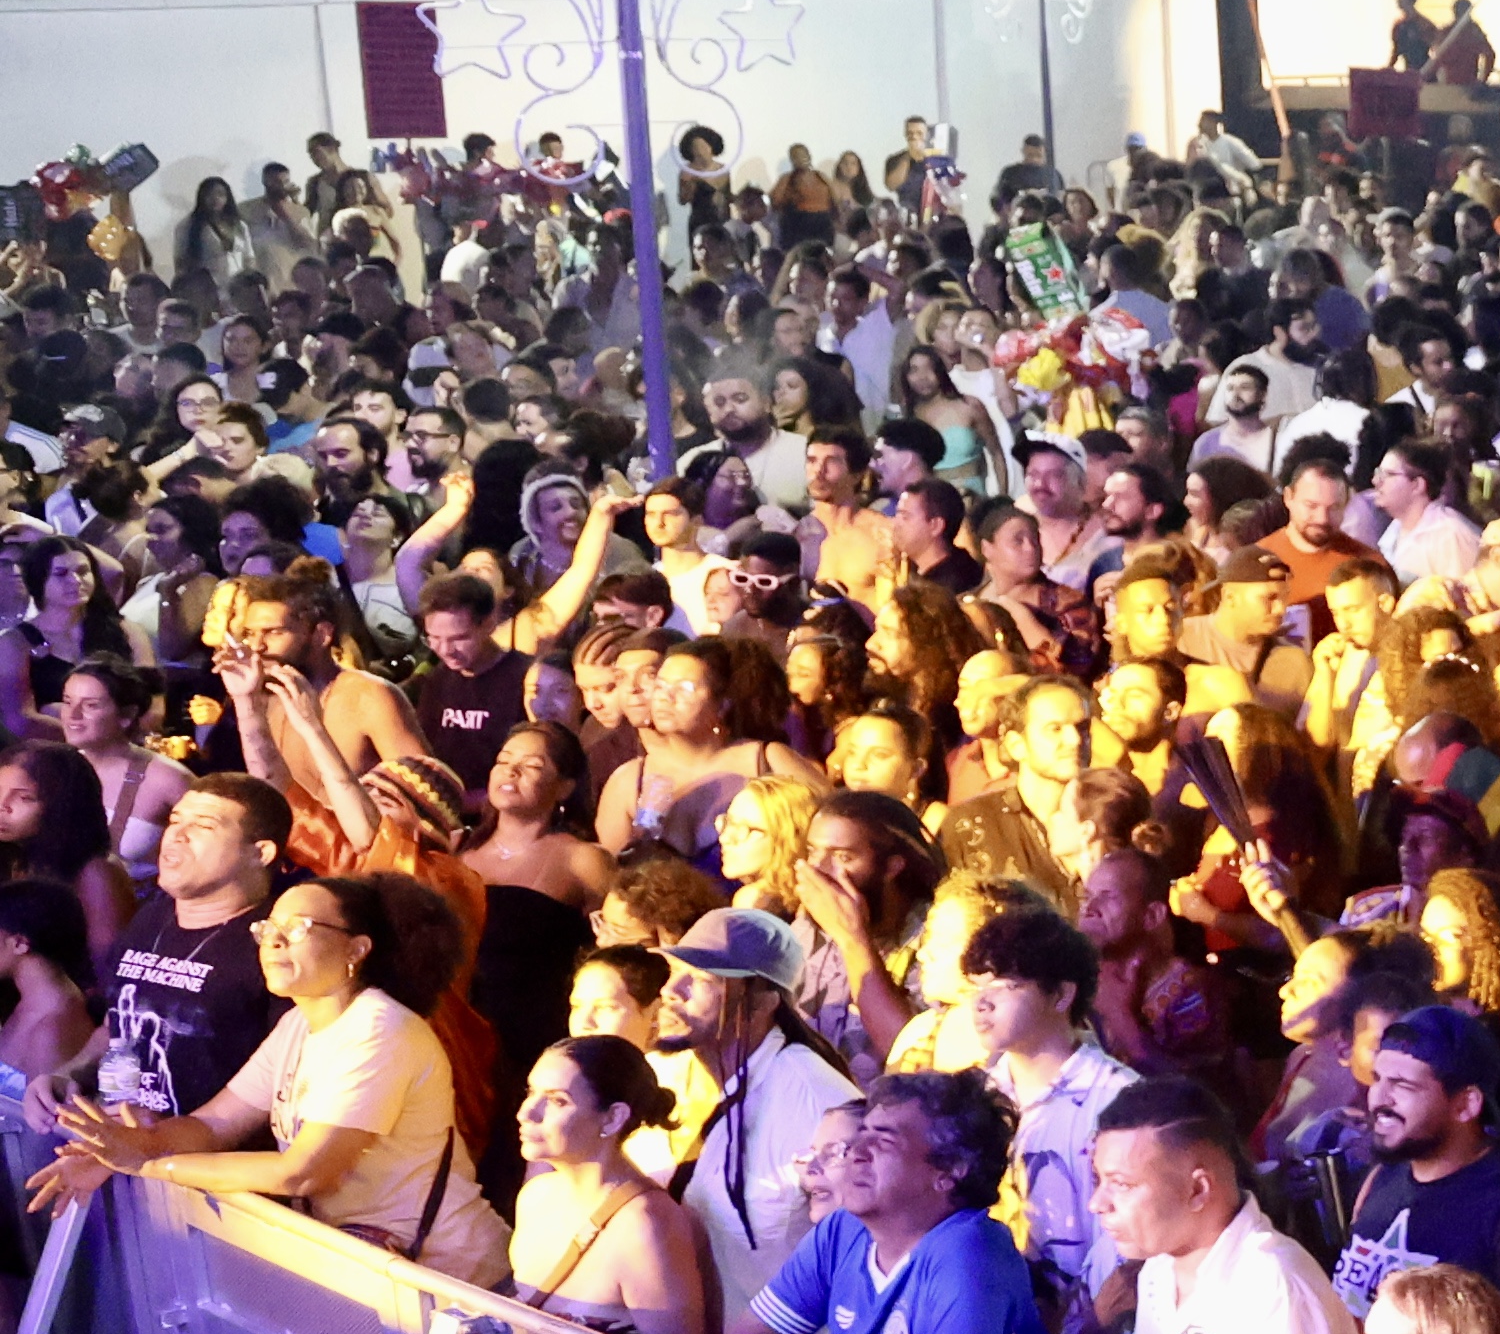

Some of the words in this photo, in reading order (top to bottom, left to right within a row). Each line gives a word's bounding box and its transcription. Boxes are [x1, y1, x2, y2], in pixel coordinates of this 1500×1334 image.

[116, 963, 142, 980] THE
[143, 967, 204, 993] MACHINE
[121, 949, 159, 970] RAGE
[157, 956, 214, 979] AGAINST
